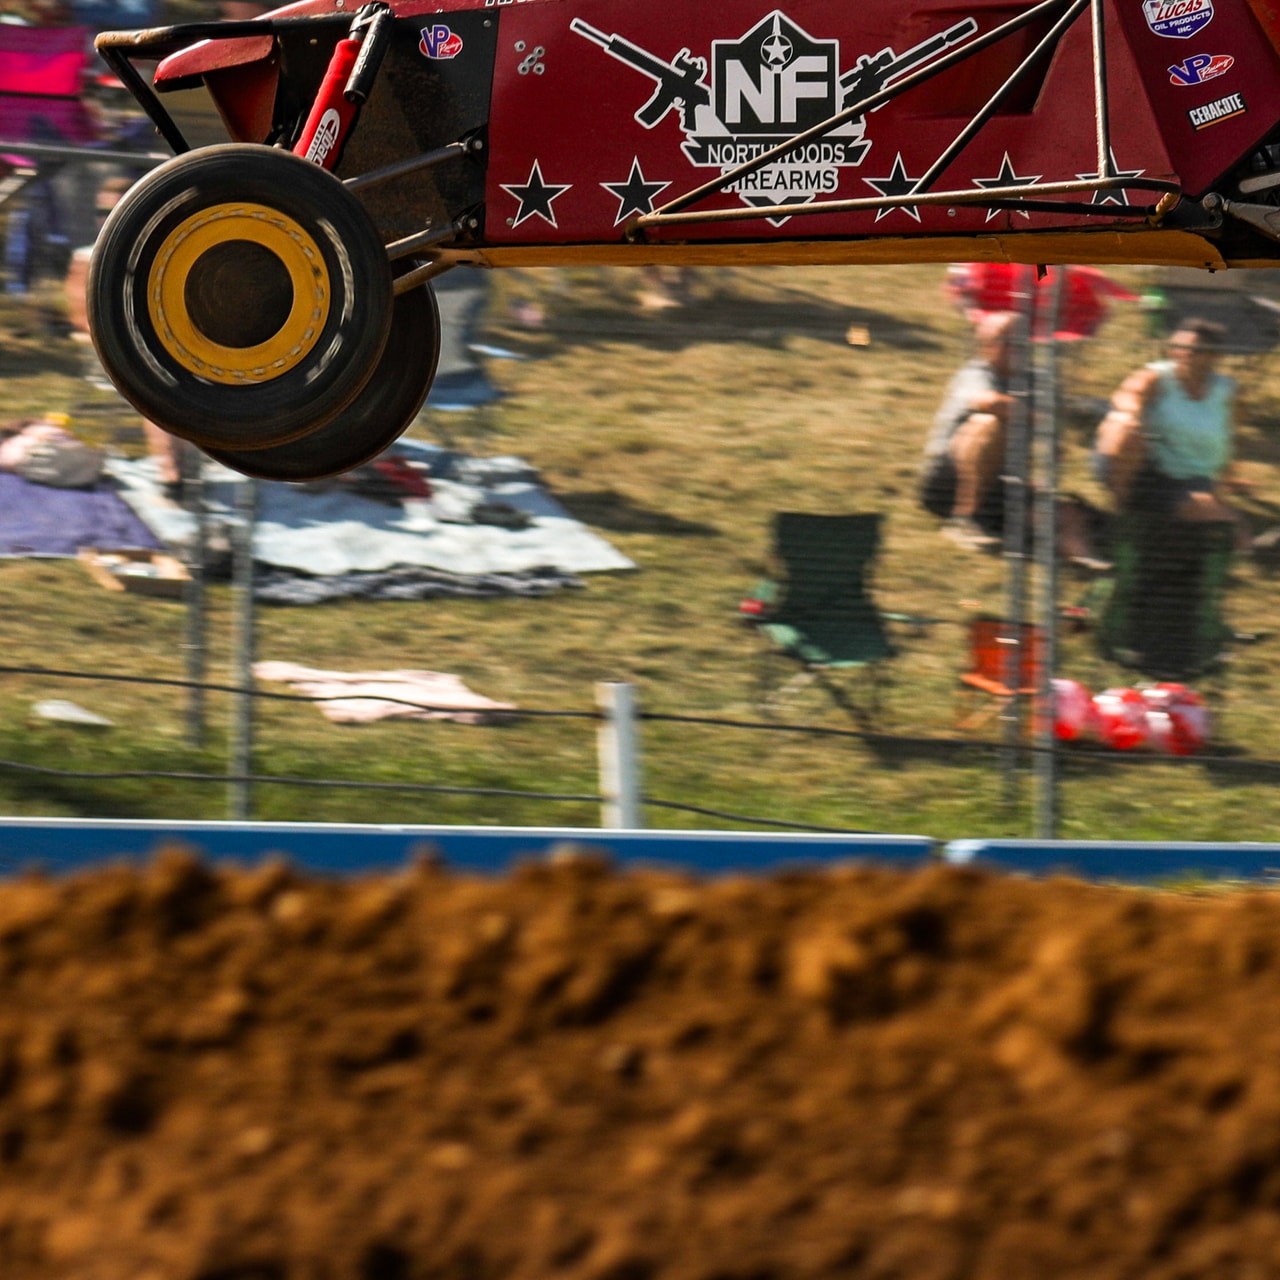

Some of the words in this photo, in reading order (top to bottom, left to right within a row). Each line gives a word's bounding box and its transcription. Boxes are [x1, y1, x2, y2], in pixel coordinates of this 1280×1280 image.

[1154, 23, 1168, 31] OIL
[1170, 10, 1211, 27] PRODUCTS
[421, 25, 450, 58] VP
[1169, 54, 1212, 84] VP
[725, 55, 828, 123] NF
[1189, 93, 1244, 125] CERAKOTE
[307, 108, 341, 167] Eibac
[708, 143, 846, 164] NORTOODS
[723, 170, 836, 190] IREARMS
